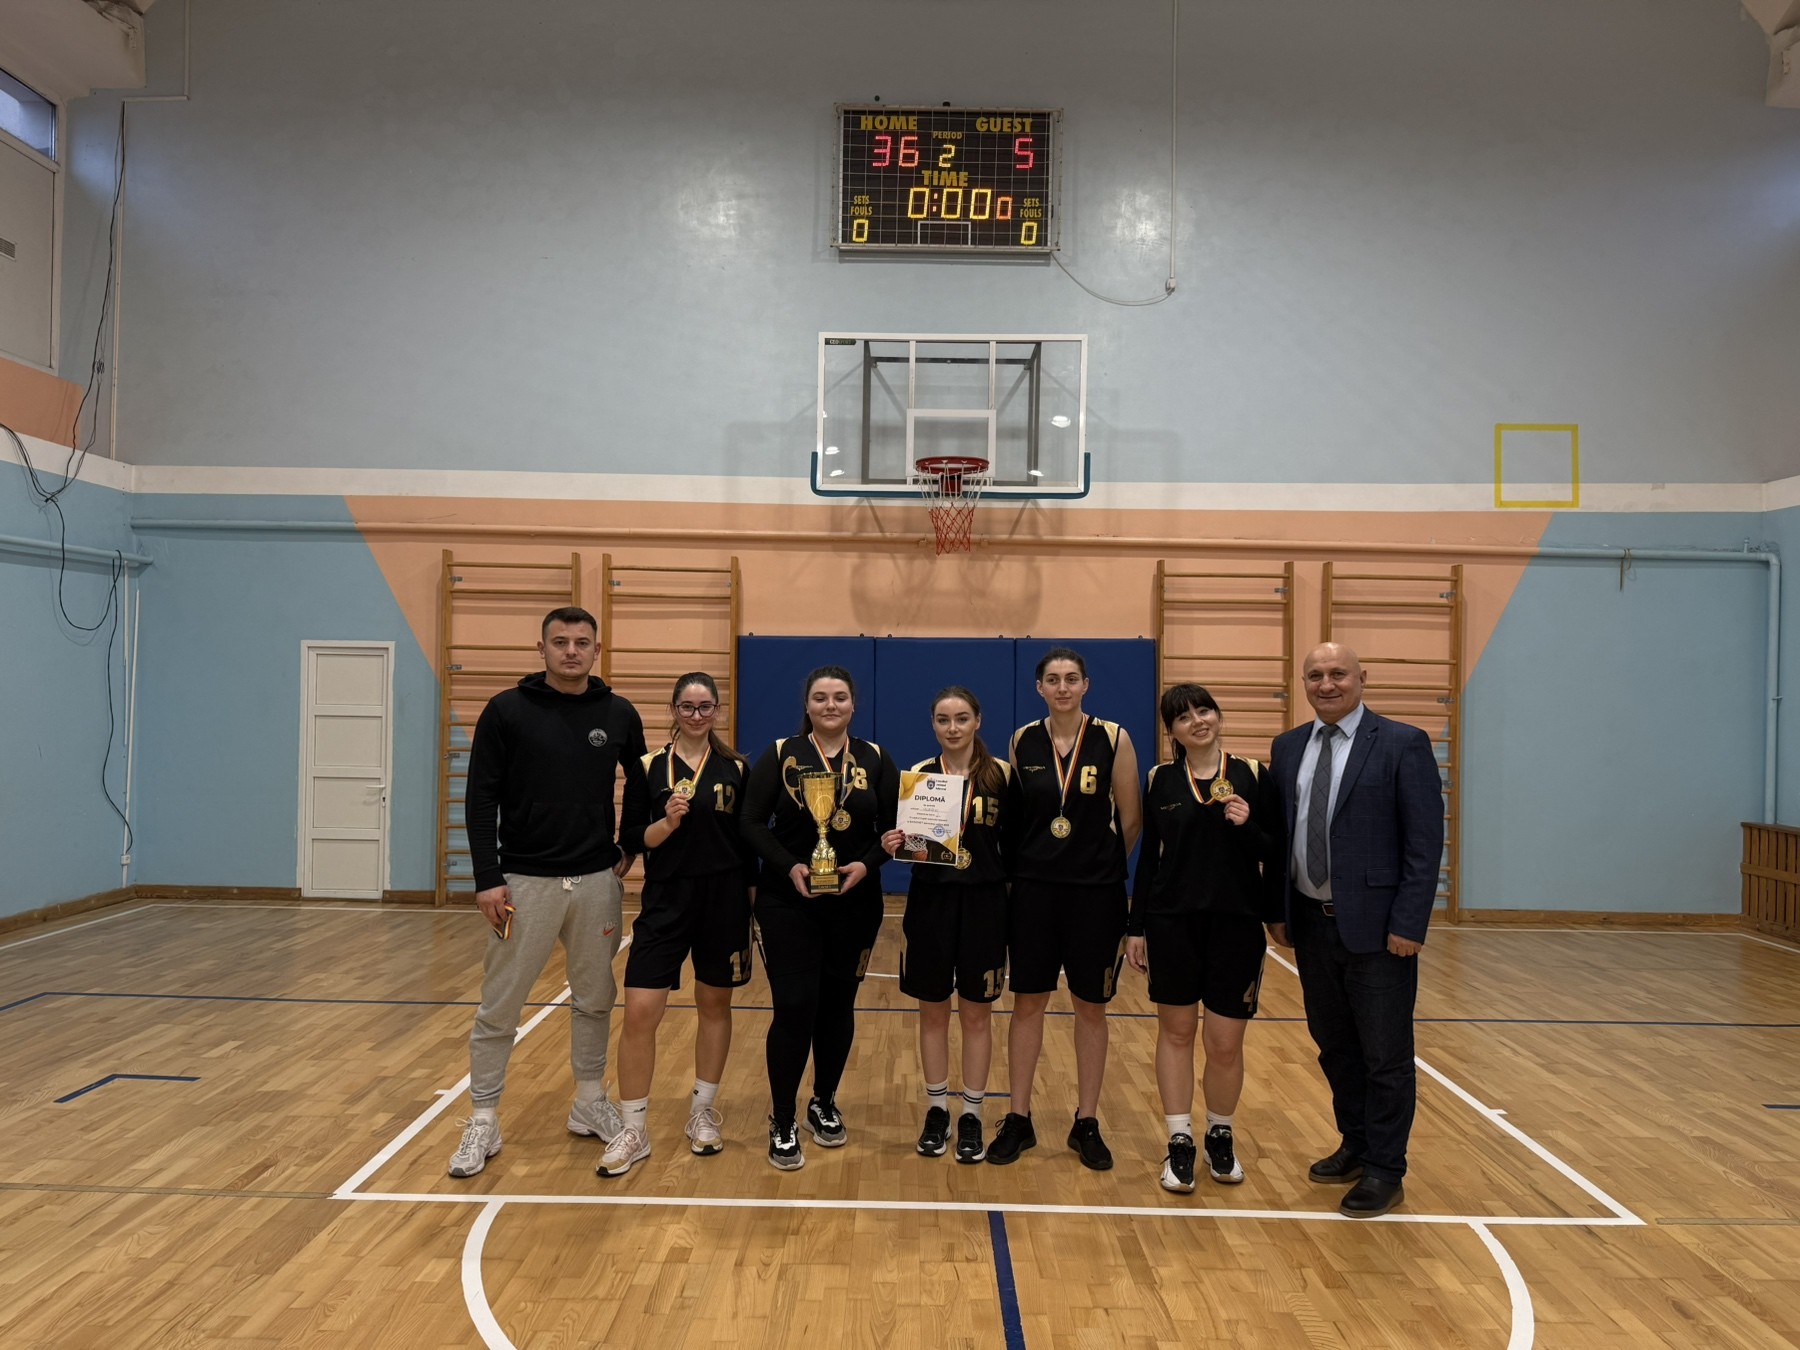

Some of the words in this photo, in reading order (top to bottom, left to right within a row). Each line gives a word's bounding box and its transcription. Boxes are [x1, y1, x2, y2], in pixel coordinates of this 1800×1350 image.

[860, 115, 918, 131] HOME
[975, 117, 1033, 133] GUEST
[932, 130, 963, 140] PERIOD
[872, 136, 920, 167] 36
[938, 144, 956, 168] 2
[1013, 137, 1034, 169] 5
[921, 170, 969, 187] TIME
[853, 195, 870, 205] SETS
[1023, 197, 1040, 207] SETS
[850, 205, 873, 216] FOULS
[1019, 208, 1042, 218] FOULS
[852, 218, 869, 243] 0
[1020, 221, 1038, 245] 0
[1080, 765, 1098, 795] 6
[713, 783, 736, 815] 12
[914, 794, 946, 803] DIPLOMĂ
[972, 795, 999, 827] 15
